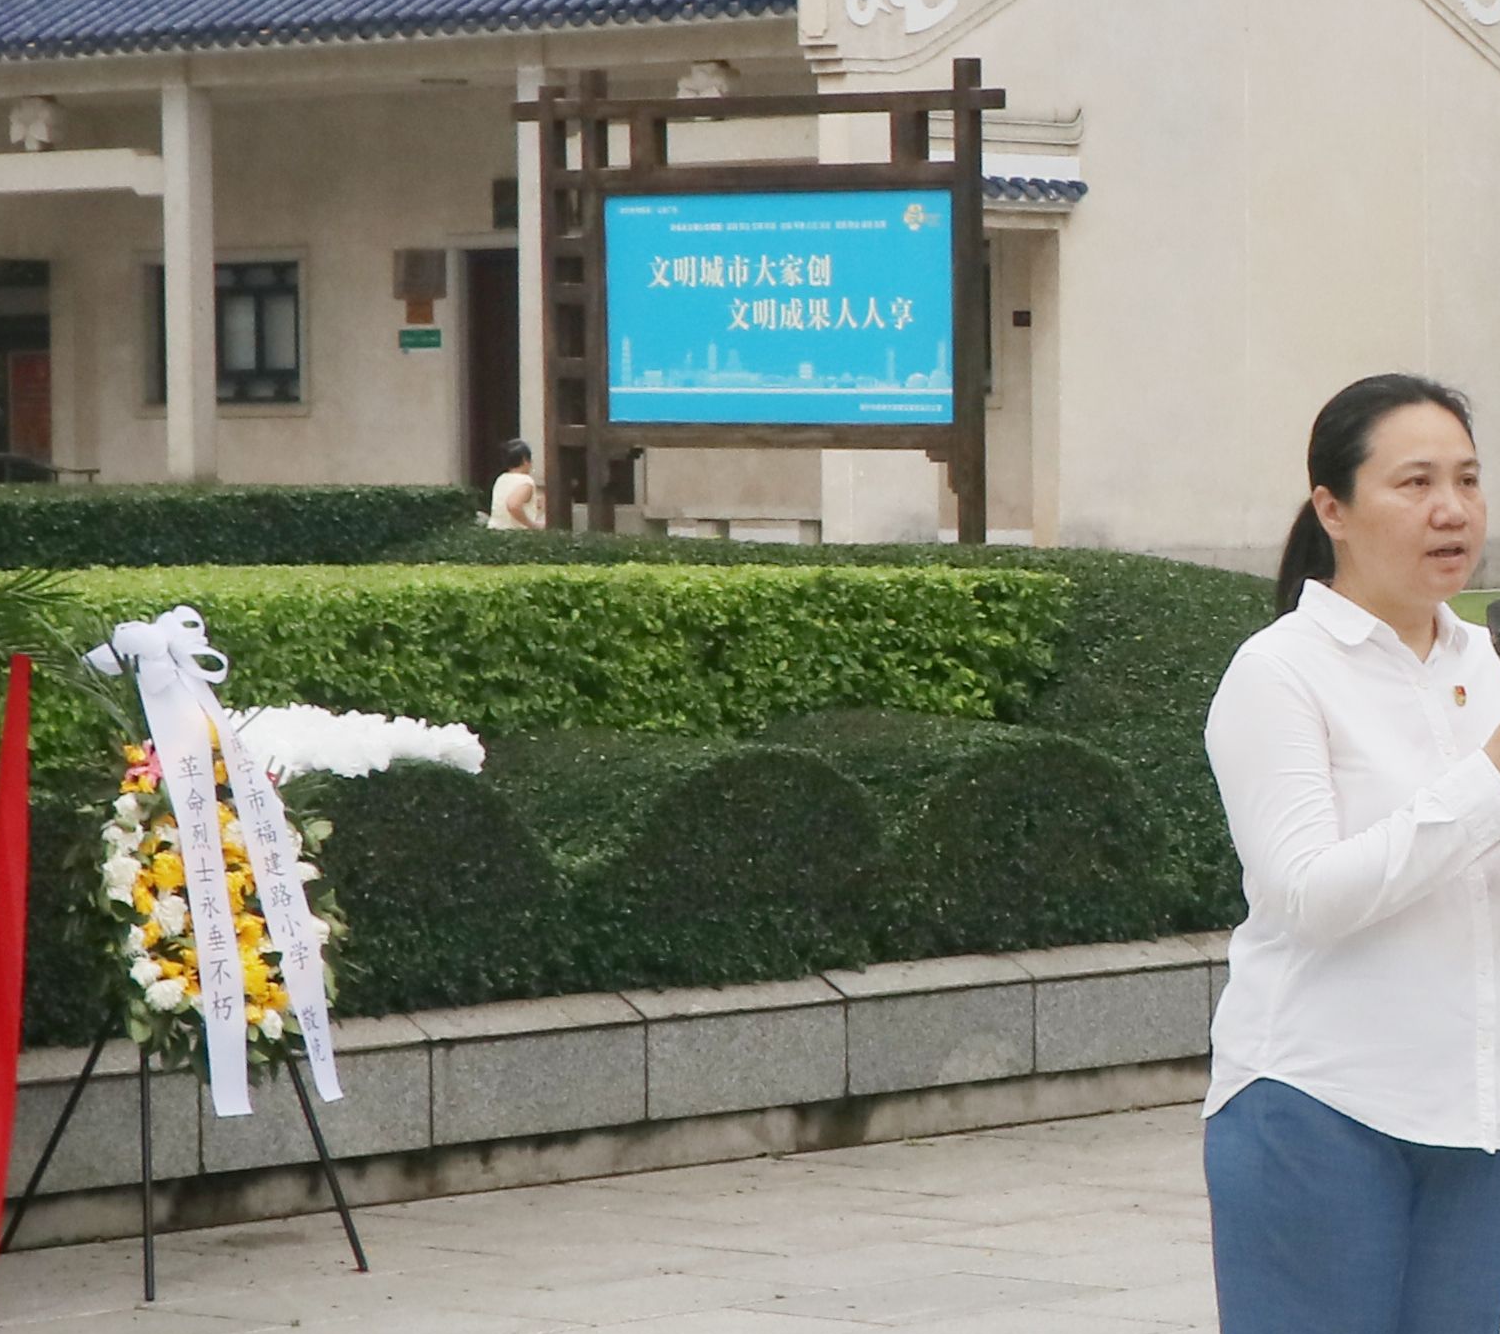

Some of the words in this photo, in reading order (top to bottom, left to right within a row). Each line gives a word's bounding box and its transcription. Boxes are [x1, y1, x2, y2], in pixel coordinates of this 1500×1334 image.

[648, 254, 832, 288] 文明城市大家创
[728, 297, 913, 331] 文明成果人人享
[177, 754, 233, 1022] 革命烈士永垂不朽
